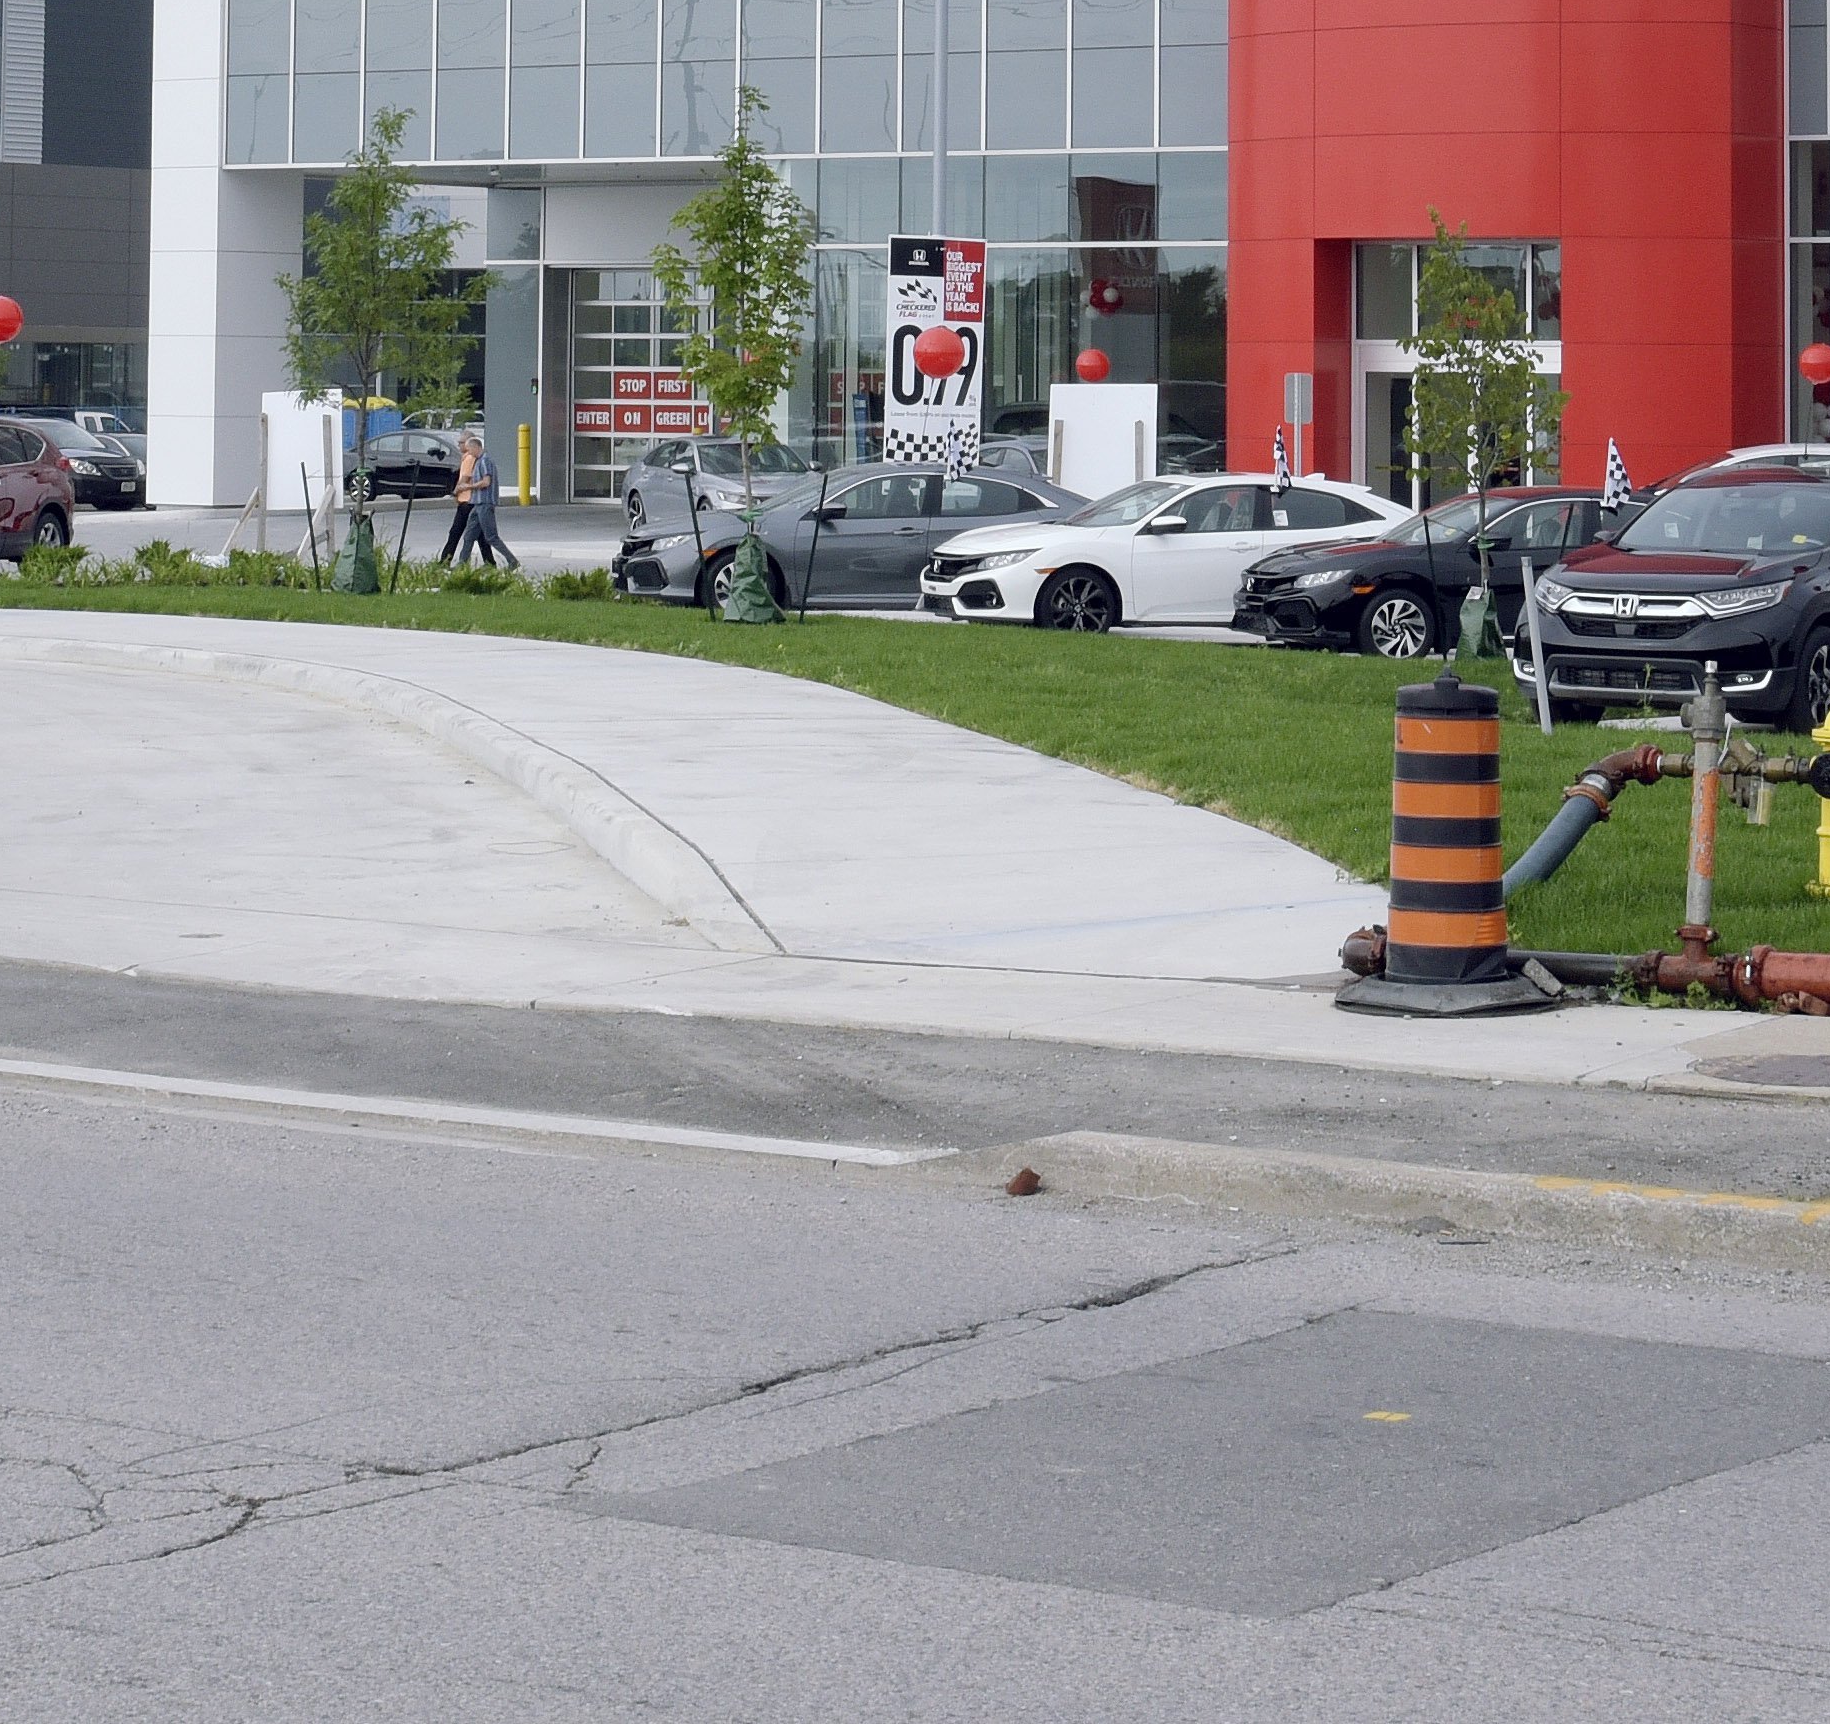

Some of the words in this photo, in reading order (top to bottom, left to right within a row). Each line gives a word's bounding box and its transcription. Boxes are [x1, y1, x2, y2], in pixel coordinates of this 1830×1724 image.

[946, 251, 964, 262] OUR
[946, 272, 973, 282] EVENT
[945, 282, 956, 292] OF
[957, 282, 974, 293] THE
[945, 292, 966, 302] YEAR
[619, 379, 647, 393] STOP
[657, 379, 688, 393] FIRST
[576, 411, 610, 425] ENTER
[623, 411, 641, 425] ON
[656, 411, 691, 426] GREEN
